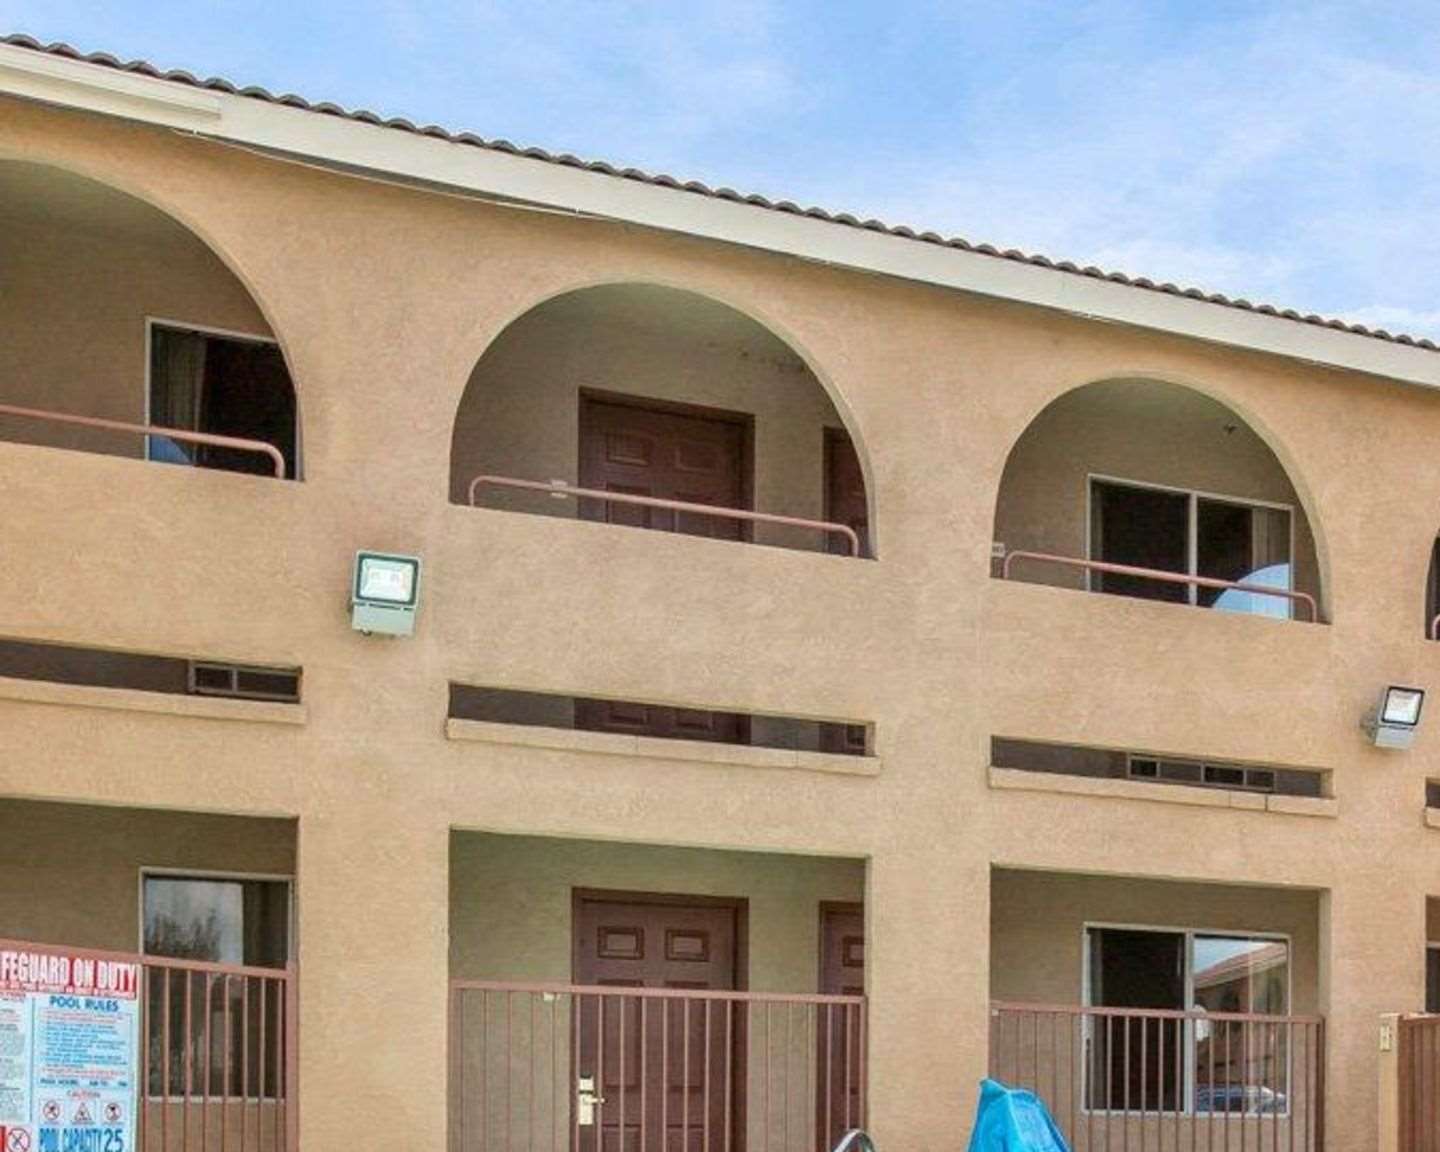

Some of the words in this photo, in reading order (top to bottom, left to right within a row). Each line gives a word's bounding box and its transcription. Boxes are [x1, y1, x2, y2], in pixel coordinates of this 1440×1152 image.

[73, 957, 94, 988] ON
[97, 960, 137, 992] DUTY
[49, 996, 80, 1010] POOL
[84, 998, 119, 1013] RULES
